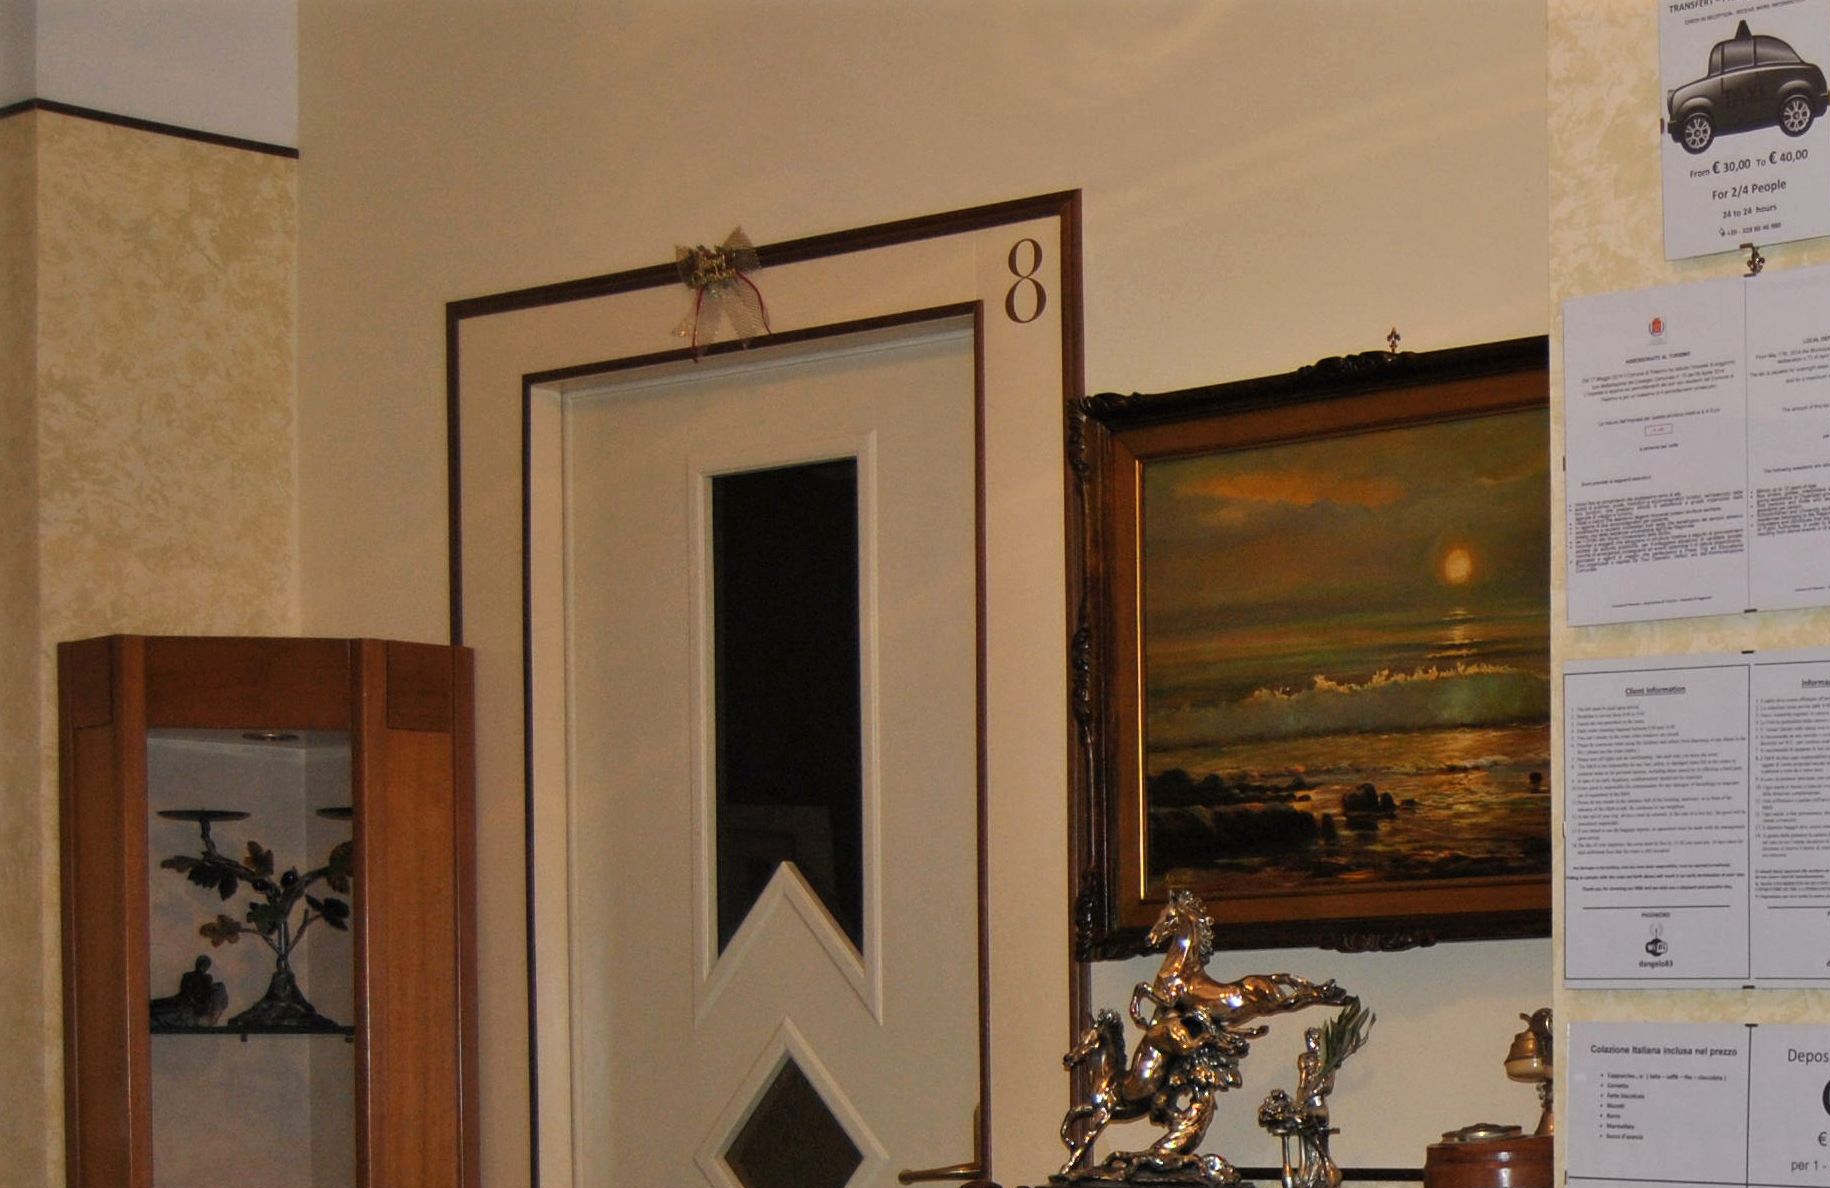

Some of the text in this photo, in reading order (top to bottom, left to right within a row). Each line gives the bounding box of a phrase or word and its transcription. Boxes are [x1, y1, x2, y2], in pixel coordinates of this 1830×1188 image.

[1689, 168, 1711, 179] From
[1723, 159, 1751, 173] 30,00
[1757, 159, 1766, 168] To
[1780, 149, 1809, 163] 40,00
[1712, 179, 1787, 200] For 2/4 People
[1005, 238, 1047, 324] 8
[1625, 687, 1645, 695] Client
[1590, 1044, 1630, 1055] Colazione
[1695, 1046, 1708, 1056] nel
[1709, 1048, 1738, 1057] prezzo
[1817, 1131, 1828, 1147] €
[1791, 1161, 1810, 1173] per
